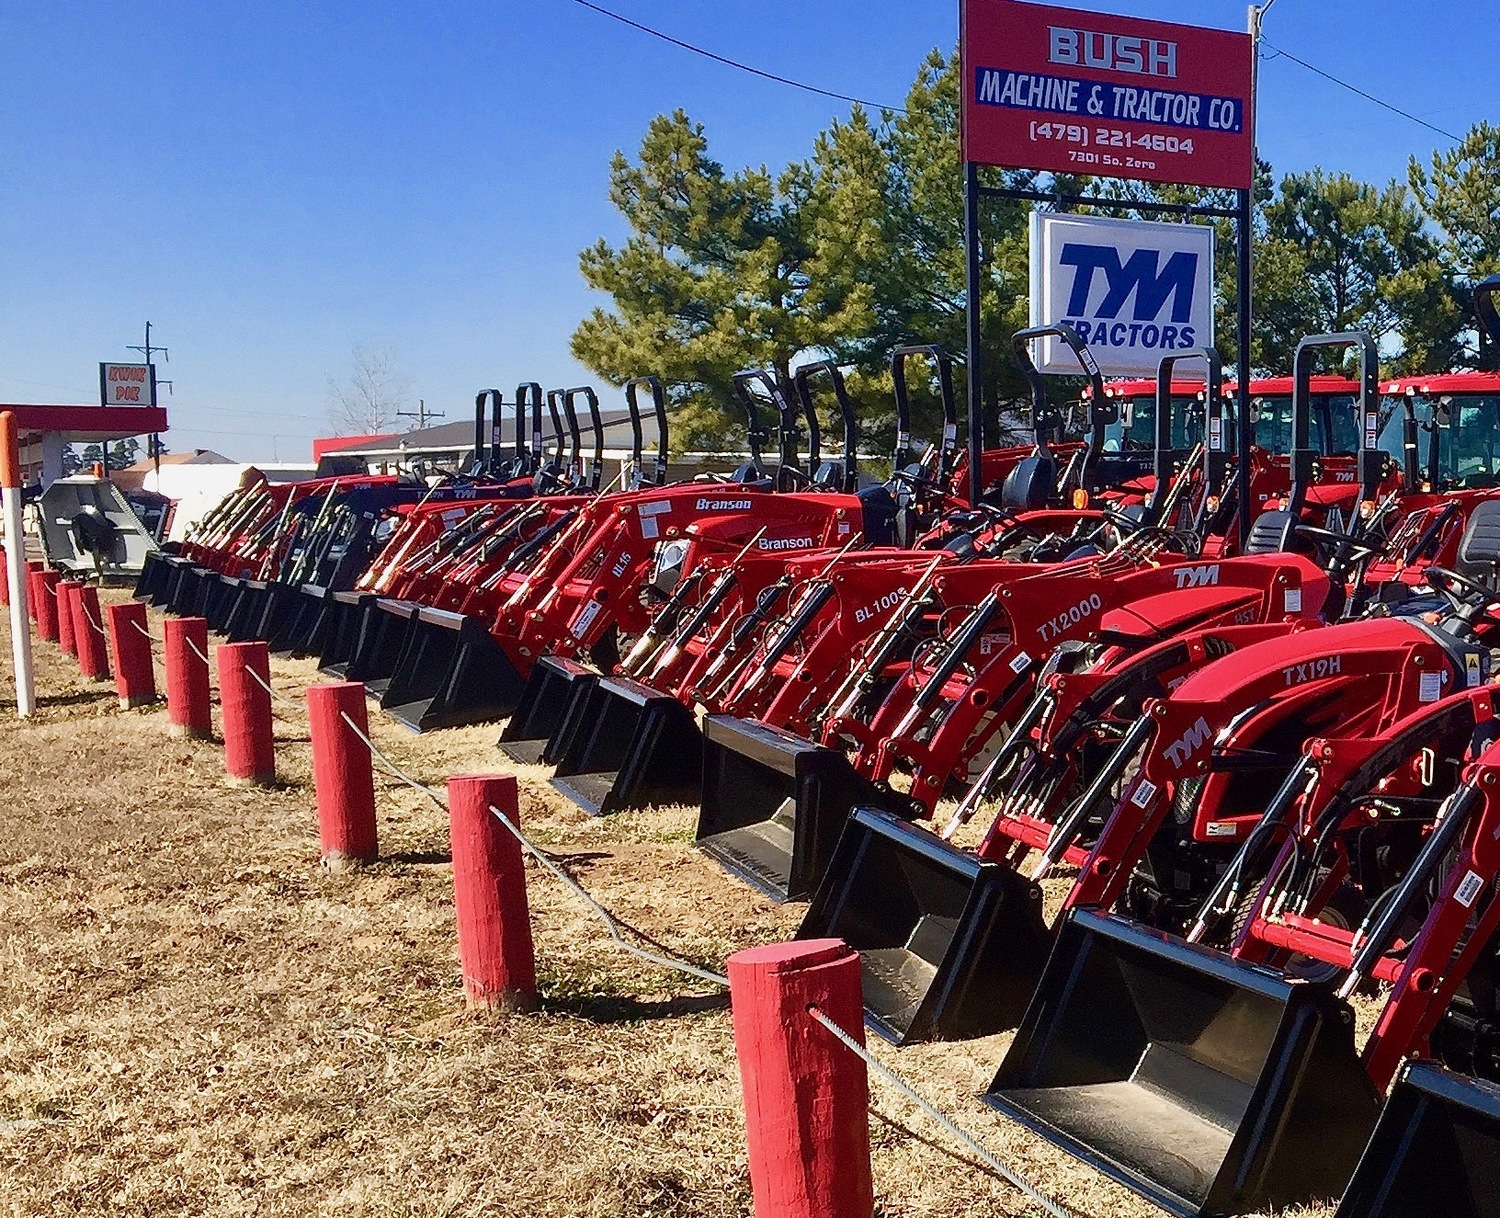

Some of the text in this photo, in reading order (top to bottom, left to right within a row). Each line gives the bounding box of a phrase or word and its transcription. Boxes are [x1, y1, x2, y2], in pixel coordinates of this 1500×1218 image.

[1047, 26, 1178, 78] BUSH
[979, 70, 1240, 131] MACHINE & TRACTOR CO.
[1029, 121, 1194, 155] (479) 221-4604
[1068, 151, 1156, 170] 7301 So. Zero
[1059, 242, 1198, 323] TYM
[109, 366, 146, 382] KWIK
[116, 386, 140, 401] PIK
[1335, 472, 1354, 481] TYM
[695, 499, 751, 510] Branson
[759, 538, 812, 550] Branson
[1173, 564, 1220, 589] TYM
[1036, 593, 1101, 644] TX2000
[1235, 607, 1255, 625] HST
[1282, 654, 1342, 686] TX19H
[1163, 716, 1212, 769] TYM
